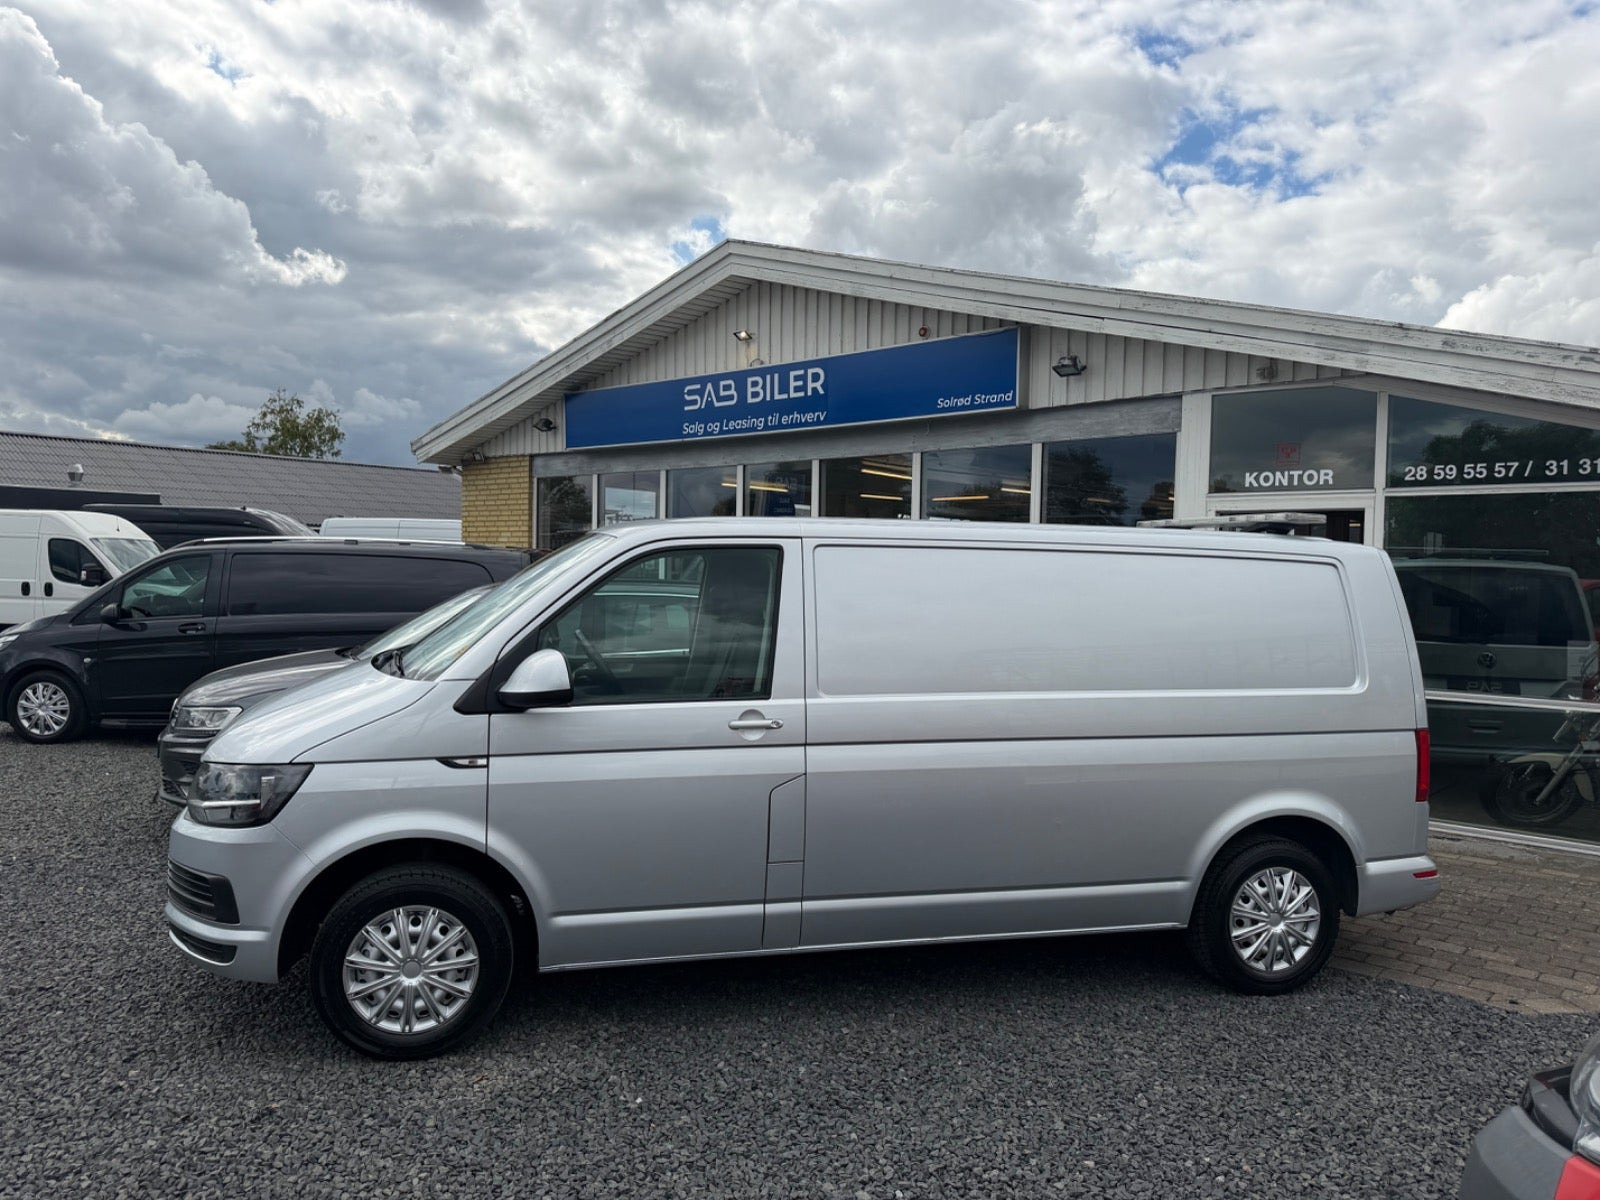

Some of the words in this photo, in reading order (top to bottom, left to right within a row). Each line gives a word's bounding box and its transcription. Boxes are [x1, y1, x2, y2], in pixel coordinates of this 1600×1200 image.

[684, 379, 738, 411] SAB
[747, 367, 825, 403] BILER
[937, 394, 972, 408] Solrød
[974, 390, 1013, 405] Strand
[682, 421, 704, 436] Salg
[706, 422, 720, 434] og
[723, 416, 765, 431] Leasing
[768, 412, 780, 426] til
[782, 411, 827, 425] erhverv
[1244, 469, 1334, 487] KONTOR
[1404, 465, 1427, 481] 28
[1433, 464, 1457, 480] 59
[1463, 463, 1487, 479] 55
[1494, 462, 1519, 478] 57
[1545, 459, 1569, 476] 31
